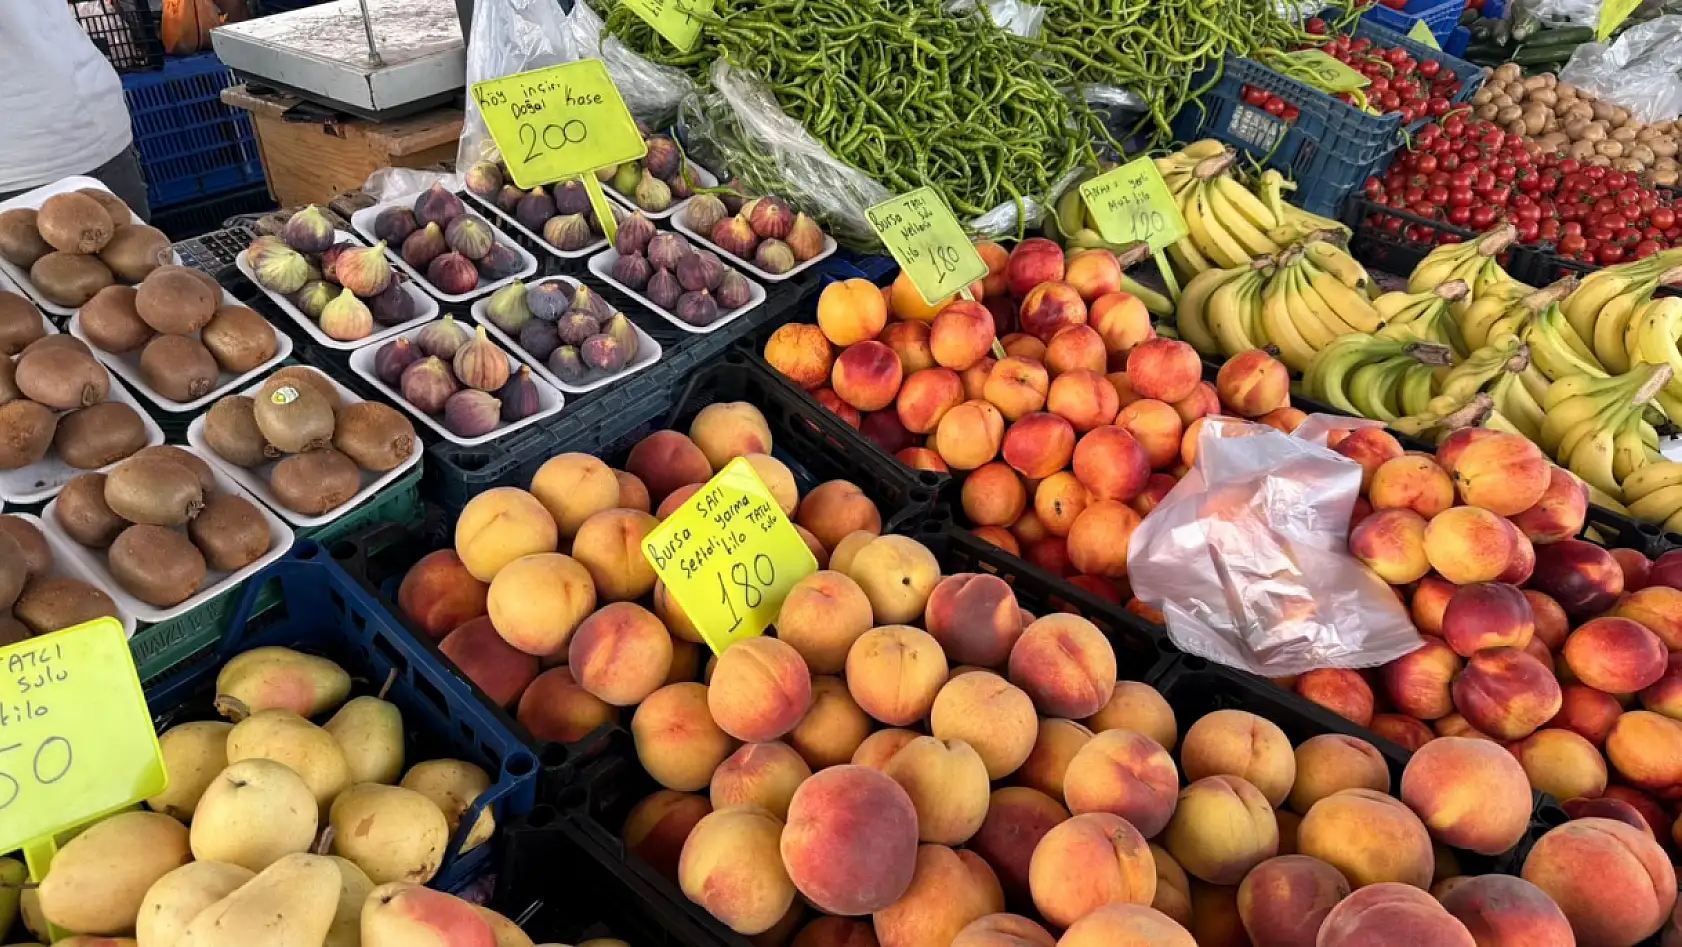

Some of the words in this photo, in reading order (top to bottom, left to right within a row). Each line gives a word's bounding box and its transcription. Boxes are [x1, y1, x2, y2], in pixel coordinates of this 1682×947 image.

[519, 119, 587, 164] 200
[927, 246, 960, 284] 180
[648, 528, 691, 571] Bursa
[717, 553, 775, 633] 180
[0, 644, 63, 672] ATLI
